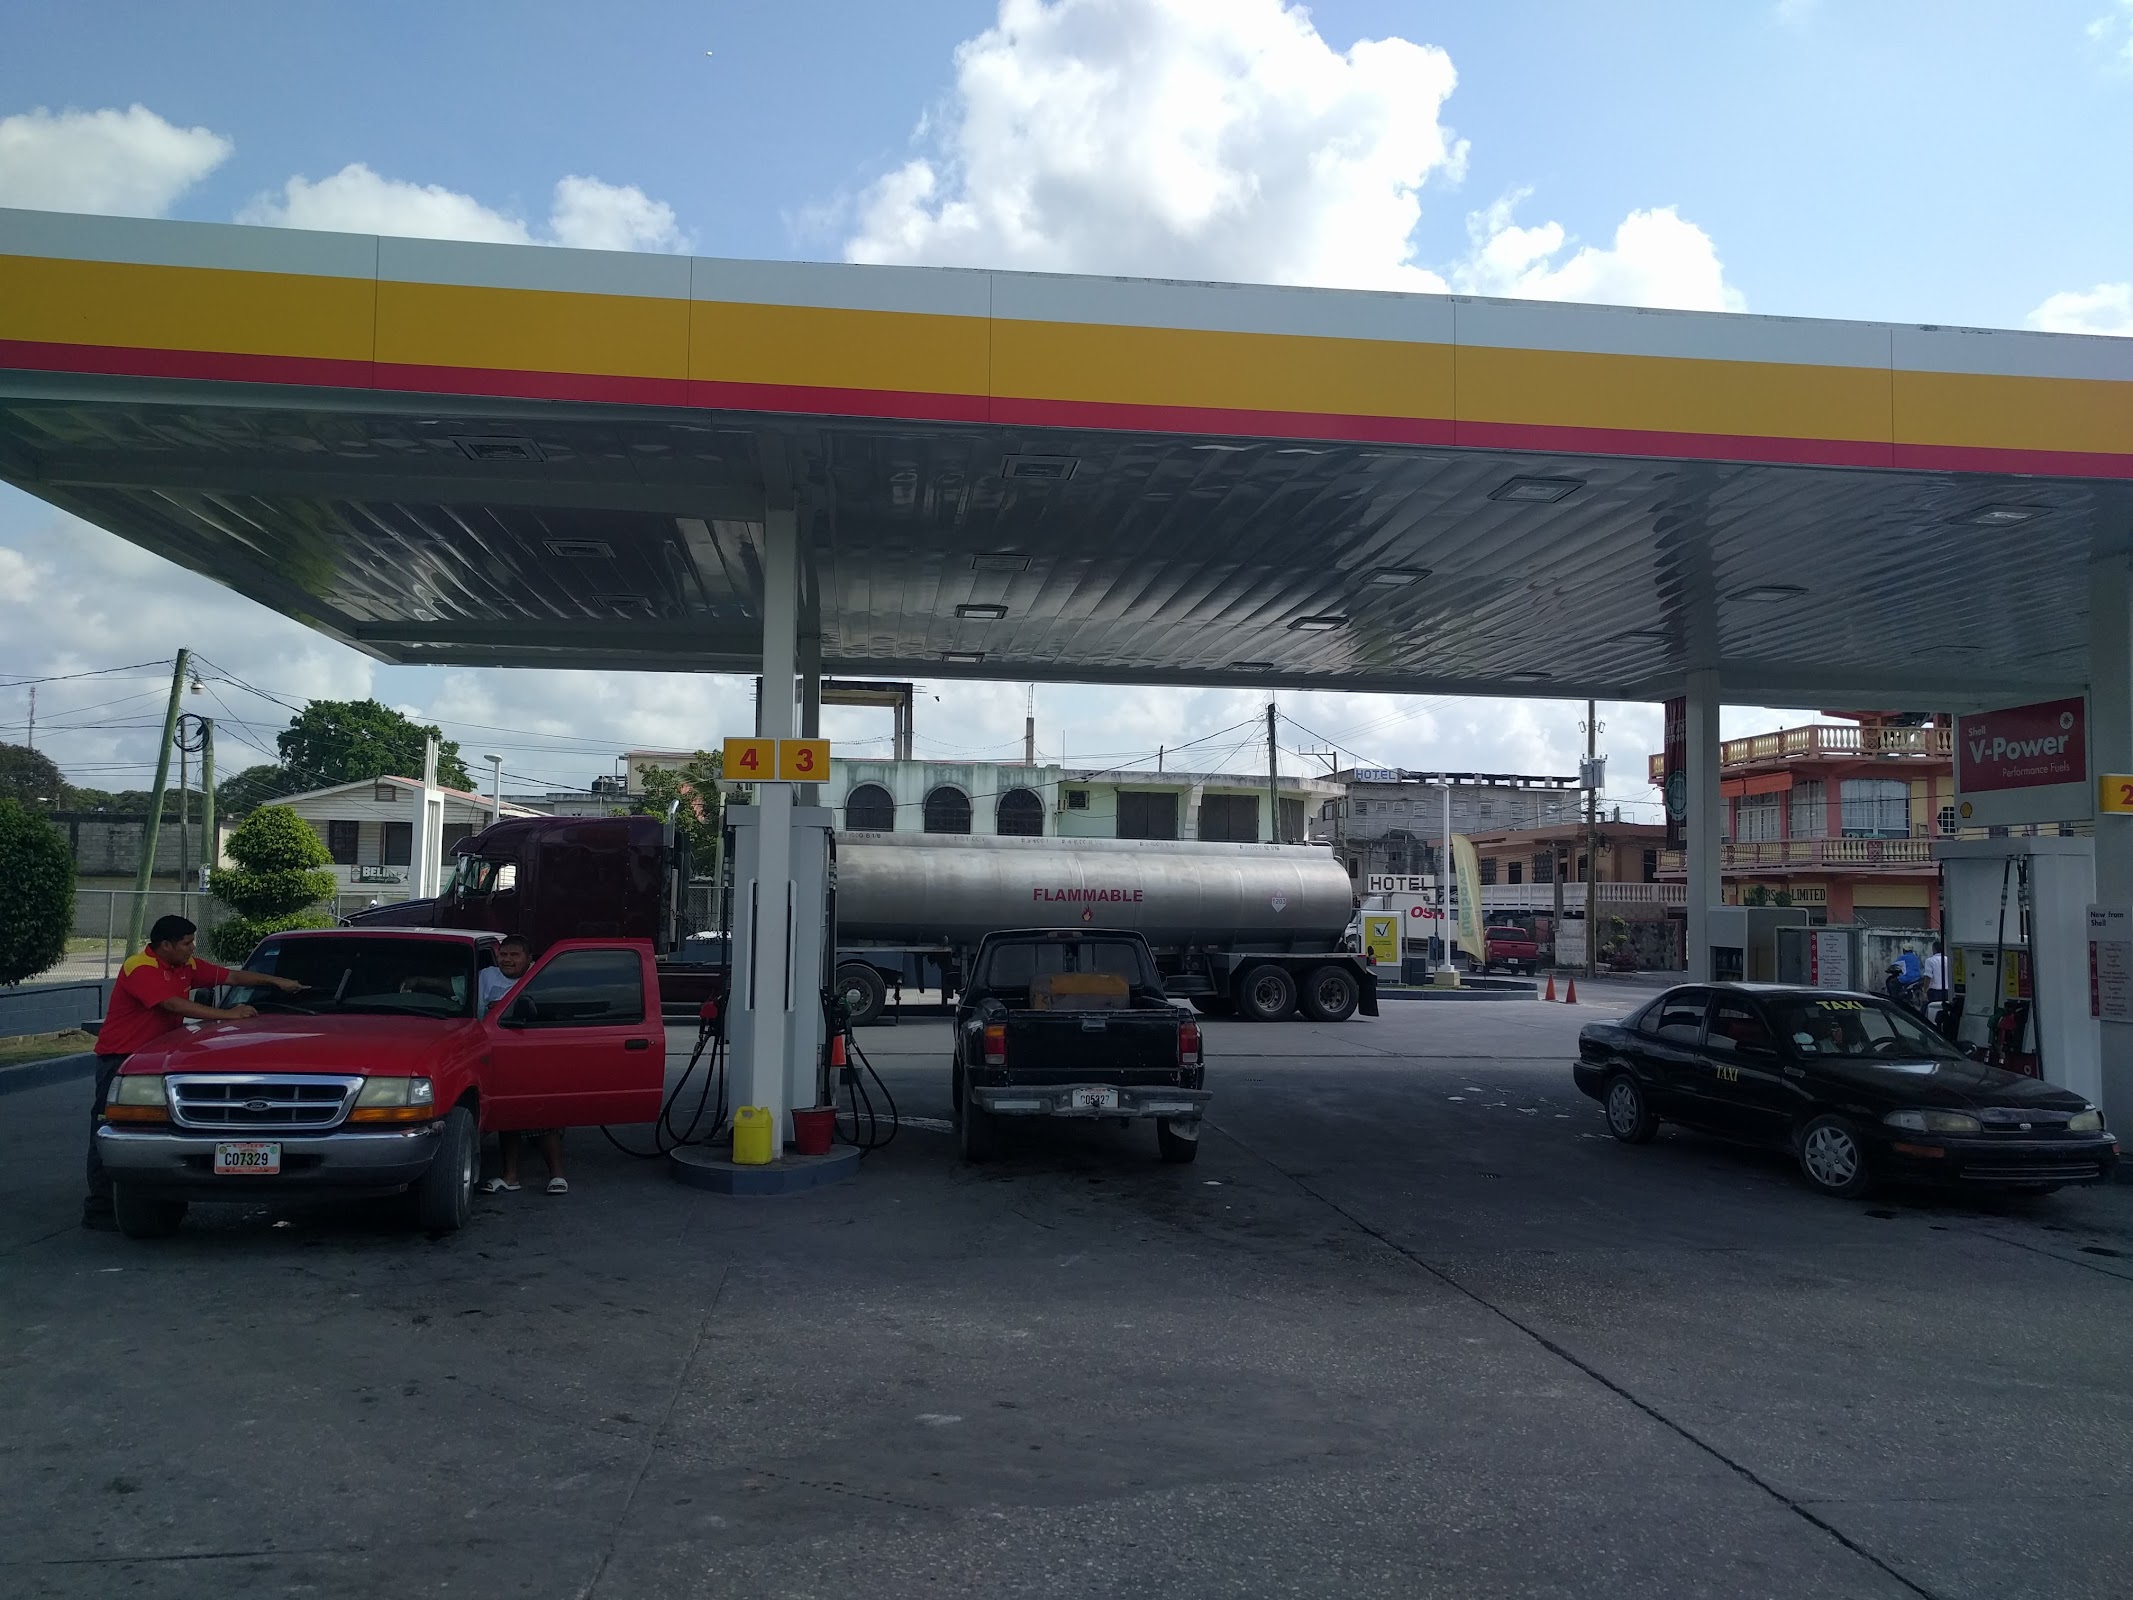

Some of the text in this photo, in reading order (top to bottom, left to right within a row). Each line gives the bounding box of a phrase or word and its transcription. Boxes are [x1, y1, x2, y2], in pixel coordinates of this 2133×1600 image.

[1969, 726, 1986, 736] Shell
[1969, 735, 2069, 764] V-Power
[740, 749, 759, 770] 4
[796, 749, 814, 771] 3
[1356, 770, 1396, 780] HOTEL
[2003, 760, 2070, 778] Performance Fuels
[2121, 784, 2133, 805] 2
[1371, 876, 1428, 891] HOTEL
[1033, 888, 1143, 902] FLAMMABLE
[1791, 888, 1826, 901] LIMITED
[2090, 919, 2107, 927] Shell
[1815, 1000, 1866, 1010] TAXI
[1716, 1064, 1739, 1083] TAXI
[225, 1152, 269, 1166] C07329
